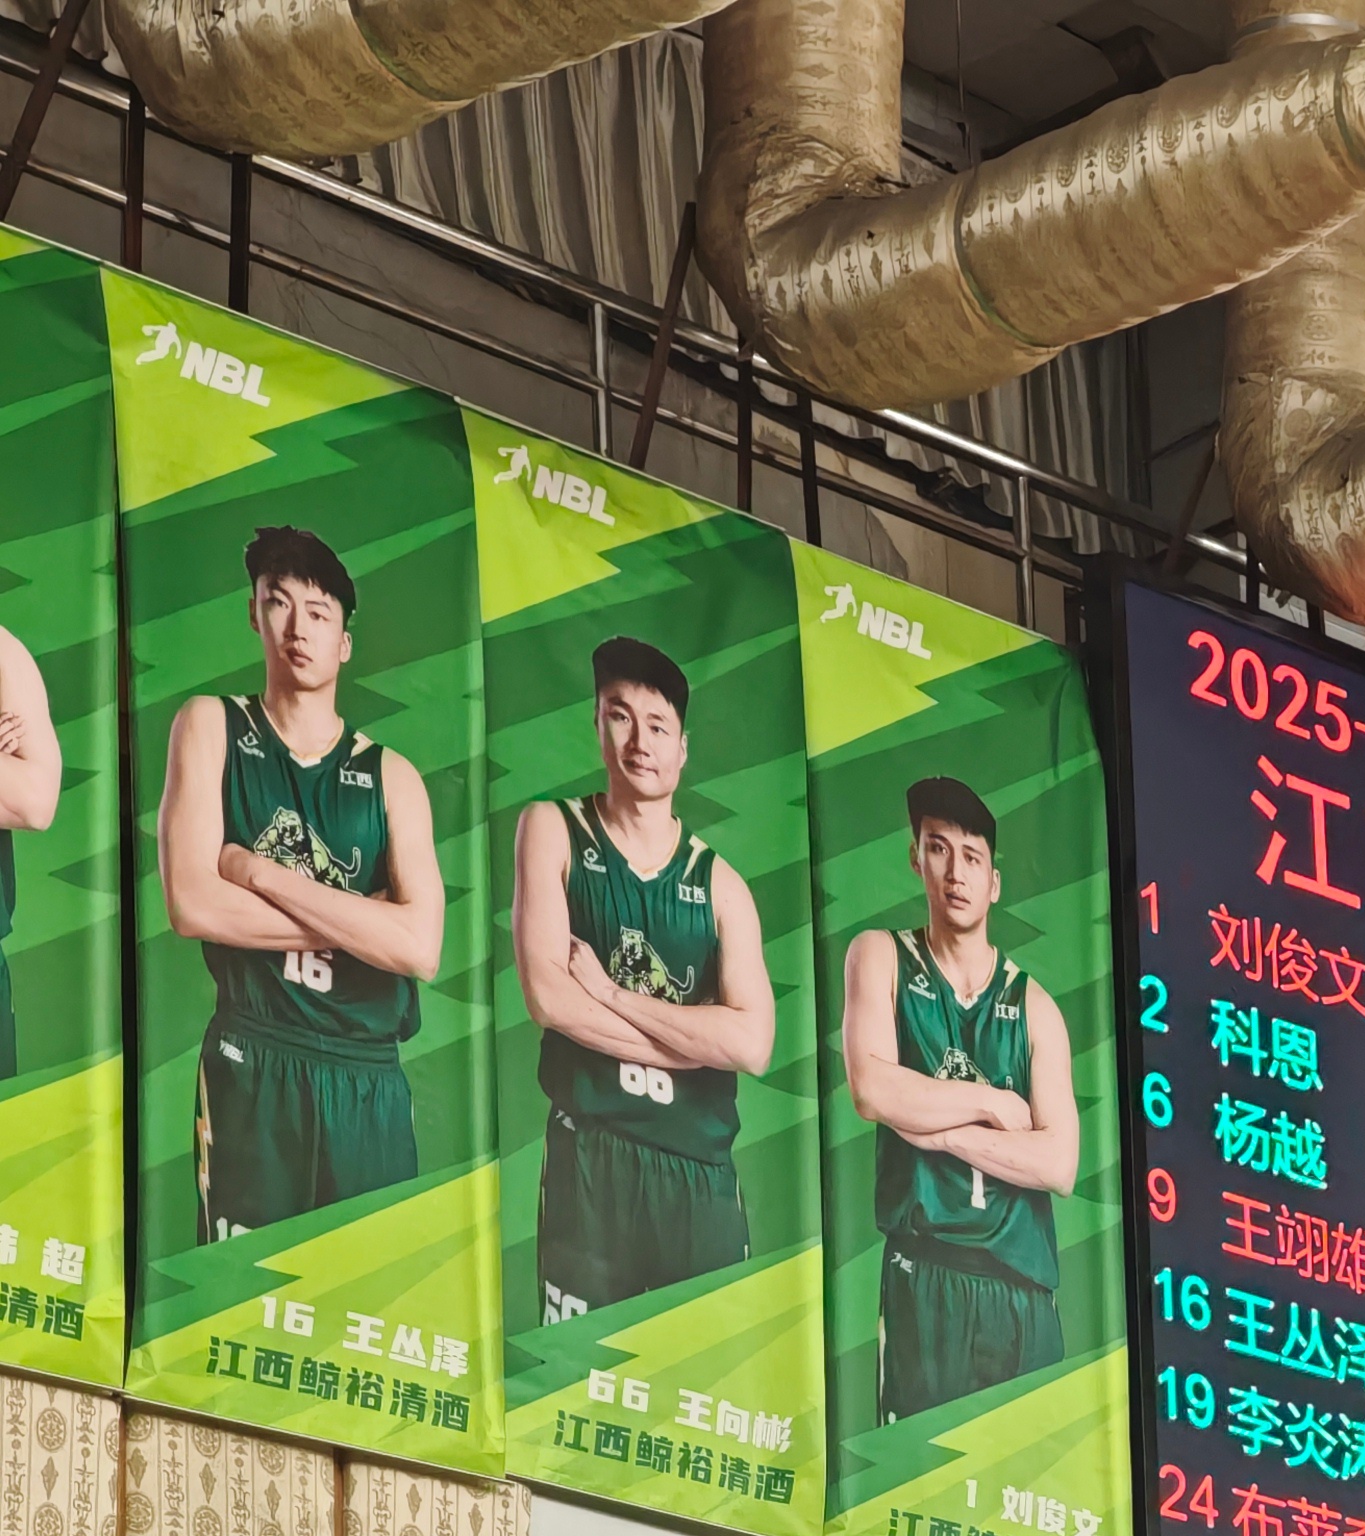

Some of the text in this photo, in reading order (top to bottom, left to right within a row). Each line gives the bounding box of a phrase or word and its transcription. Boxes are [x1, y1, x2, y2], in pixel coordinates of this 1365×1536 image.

[180, 342, 271, 407] NBL
[532, 464, 616, 527] NBL
[857, 601, 933, 660] NBL
[1140, 884, 1160, 934] 1
[1140, 976, 1169, 1034] 2
[1212, 1000, 1324, 1092] 科恩
[1143, 1072, 1173, 1129] 6
[1214, 1093, 1329, 1190] 杨越
[1147, 1170, 1178, 1224] 9
[1154, 1267, 1212, 1332] 16
[261, 1295, 470, 1379] 16 王丛泽
[206, 1335, 471, 1433] 江西鲸裕清酒
[587, 1367, 793, 1454] 66 王向彬
[1158, 1365, 1216, 1430] 19
[553, 1410, 796, 1505] 江西鲸裕清酒
[965, 1479, 977, 1508] 1
[1158, 1464, 1220, 1530] 24
